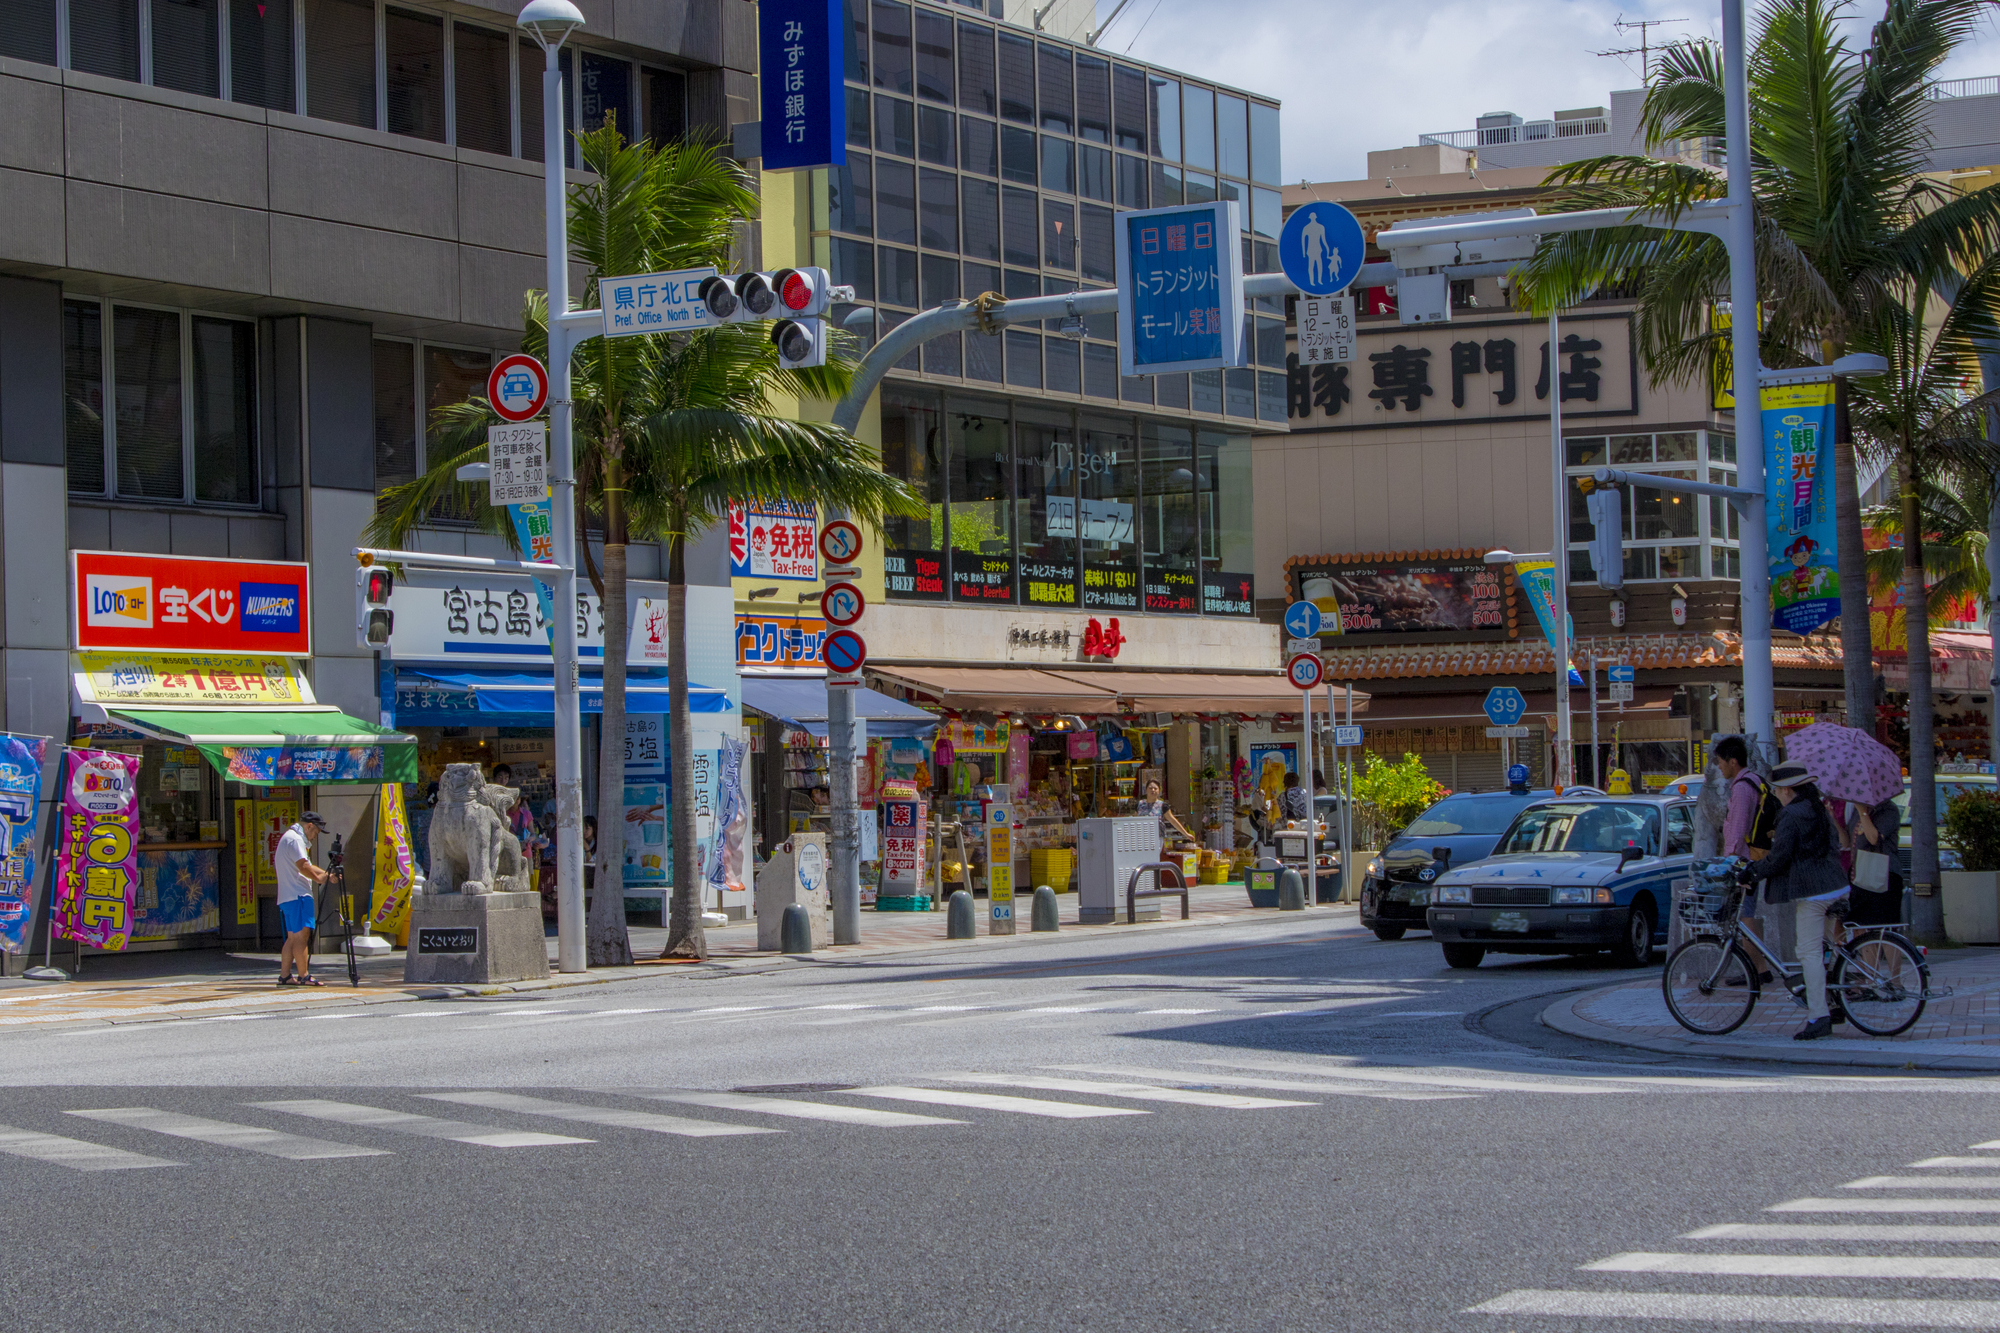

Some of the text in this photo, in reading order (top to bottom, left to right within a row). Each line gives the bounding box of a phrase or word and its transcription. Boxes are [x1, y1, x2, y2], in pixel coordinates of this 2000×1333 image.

[783, 20, 806, 144] みずほ銀行
[1141, 222, 1212, 255] 日曜日
[1137, 265, 1219, 297] トランジット
[614, 280, 704, 310] 県庁北口
[1308, 300, 1343, 316] 日曜
[614, 313, 634, 327] Pref.
[638, 311, 662, 325] Office
[667, 308, 689, 322] North
[1142, 307, 1220, 339] モール実施
[1301, 331, 1353, 347] トランジットモール
[1308, 346, 1348, 362] 実施日
[1286, 333, 1602, 419] 豚専門店
[493, 429, 541, 443] バス・タクシー
[494, 442, 542, 457] 許可車を除く
[1050, 440, 1114, 480] Tiger
[769, 523, 814, 559] 免税
[771, 559, 813, 576] Tax-Free
[916, 558, 940, 577] Tiger
[982, 560, 1010, 573] ミッドナイト
[1020, 564, 1075, 580] ビールとステーキが
[892, 576, 915, 592] BEEF
[916, 576, 943, 593] Steak
[954, 571, 968, 582] 食べる
[970, 572, 985, 583] 飲める
[1164, 573, 1194, 585] ディナータイム
[961, 584, 1010, 599] Music Beerhall
[1029, 582, 1075, 604] 那覇最大級
[1472, 584, 1500, 599] 100
[93, 586, 126, 615] LOTO
[159, 585, 234, 624] 宝くじ
[246, 596, 295, 617] NUMBERS
[1128, 593, 1137, 607] Bar
[1205, 601, 1251, 614] 世界初の新しいお店
[1476, 601, 1500, 611] 石垣
[1341, 603, 1375, 614] 生ビール
[1342, 614, 1381, 629] 500円
[1473, 611, 1501, 625] 500
[161, 657, 255, 667] 第550回 年末ジャンボ
[1296, 664, 1315, 680] 30
[1492, 697, 1517, 713] 39
[790, 732, 808, 747] 498
[294, 760, 336, 772] キャンペーン
[892, 803, 911, 826] 薬
[995, 812, 1004, 820] 39
[886, 838, 915, 852] 免税
[887, 860, 914, 868] 8%OFF
[1453, 869, 1588, 879] TAXI
[993, 907, 1010, 919] 0.4
[421, 934, 474, 949] こくさいとおり
